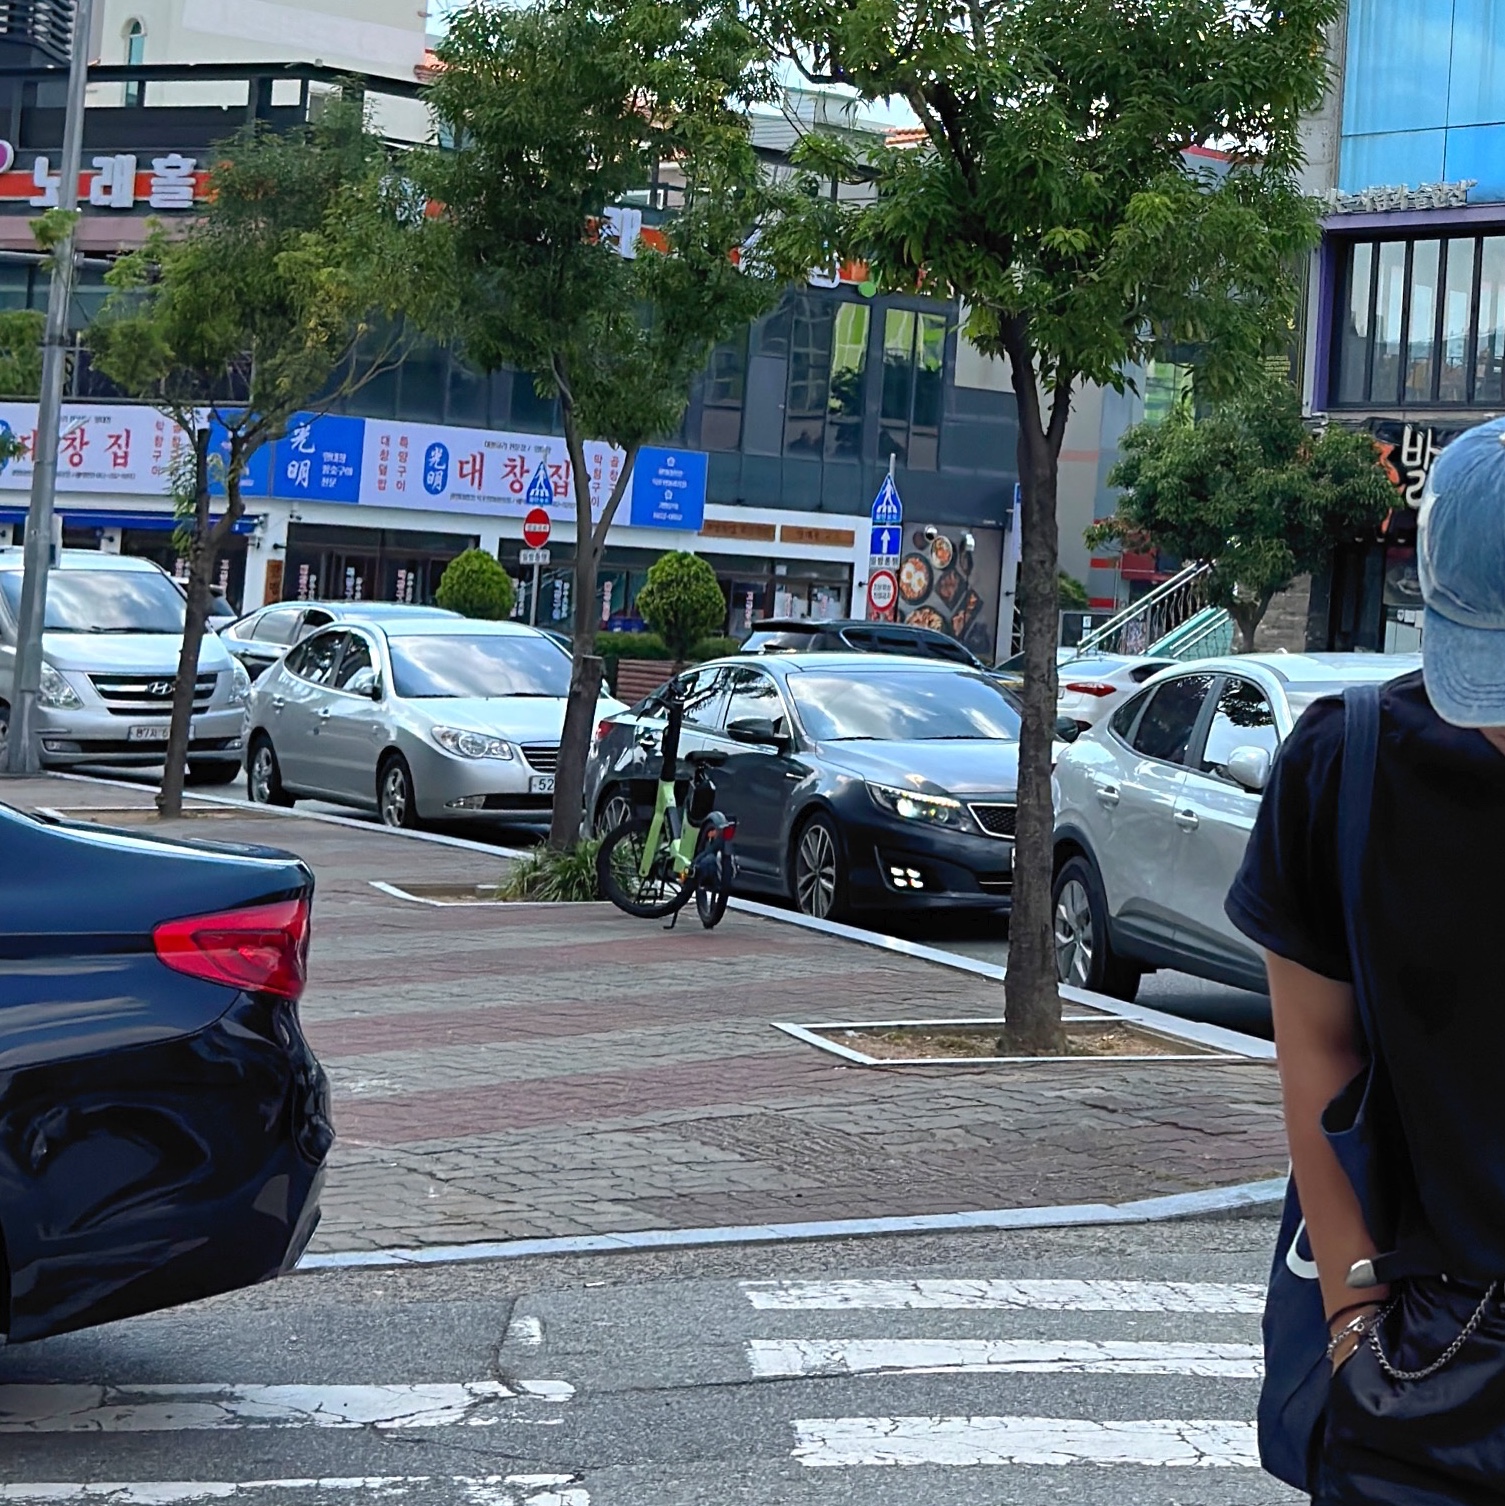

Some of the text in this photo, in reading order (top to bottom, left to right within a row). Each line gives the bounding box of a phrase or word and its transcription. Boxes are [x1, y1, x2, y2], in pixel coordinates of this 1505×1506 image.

[30, 153, 197, 208] 노래홀
[457, 451, 571, 498] 대창집
[538, 778, 555, 791] 52
